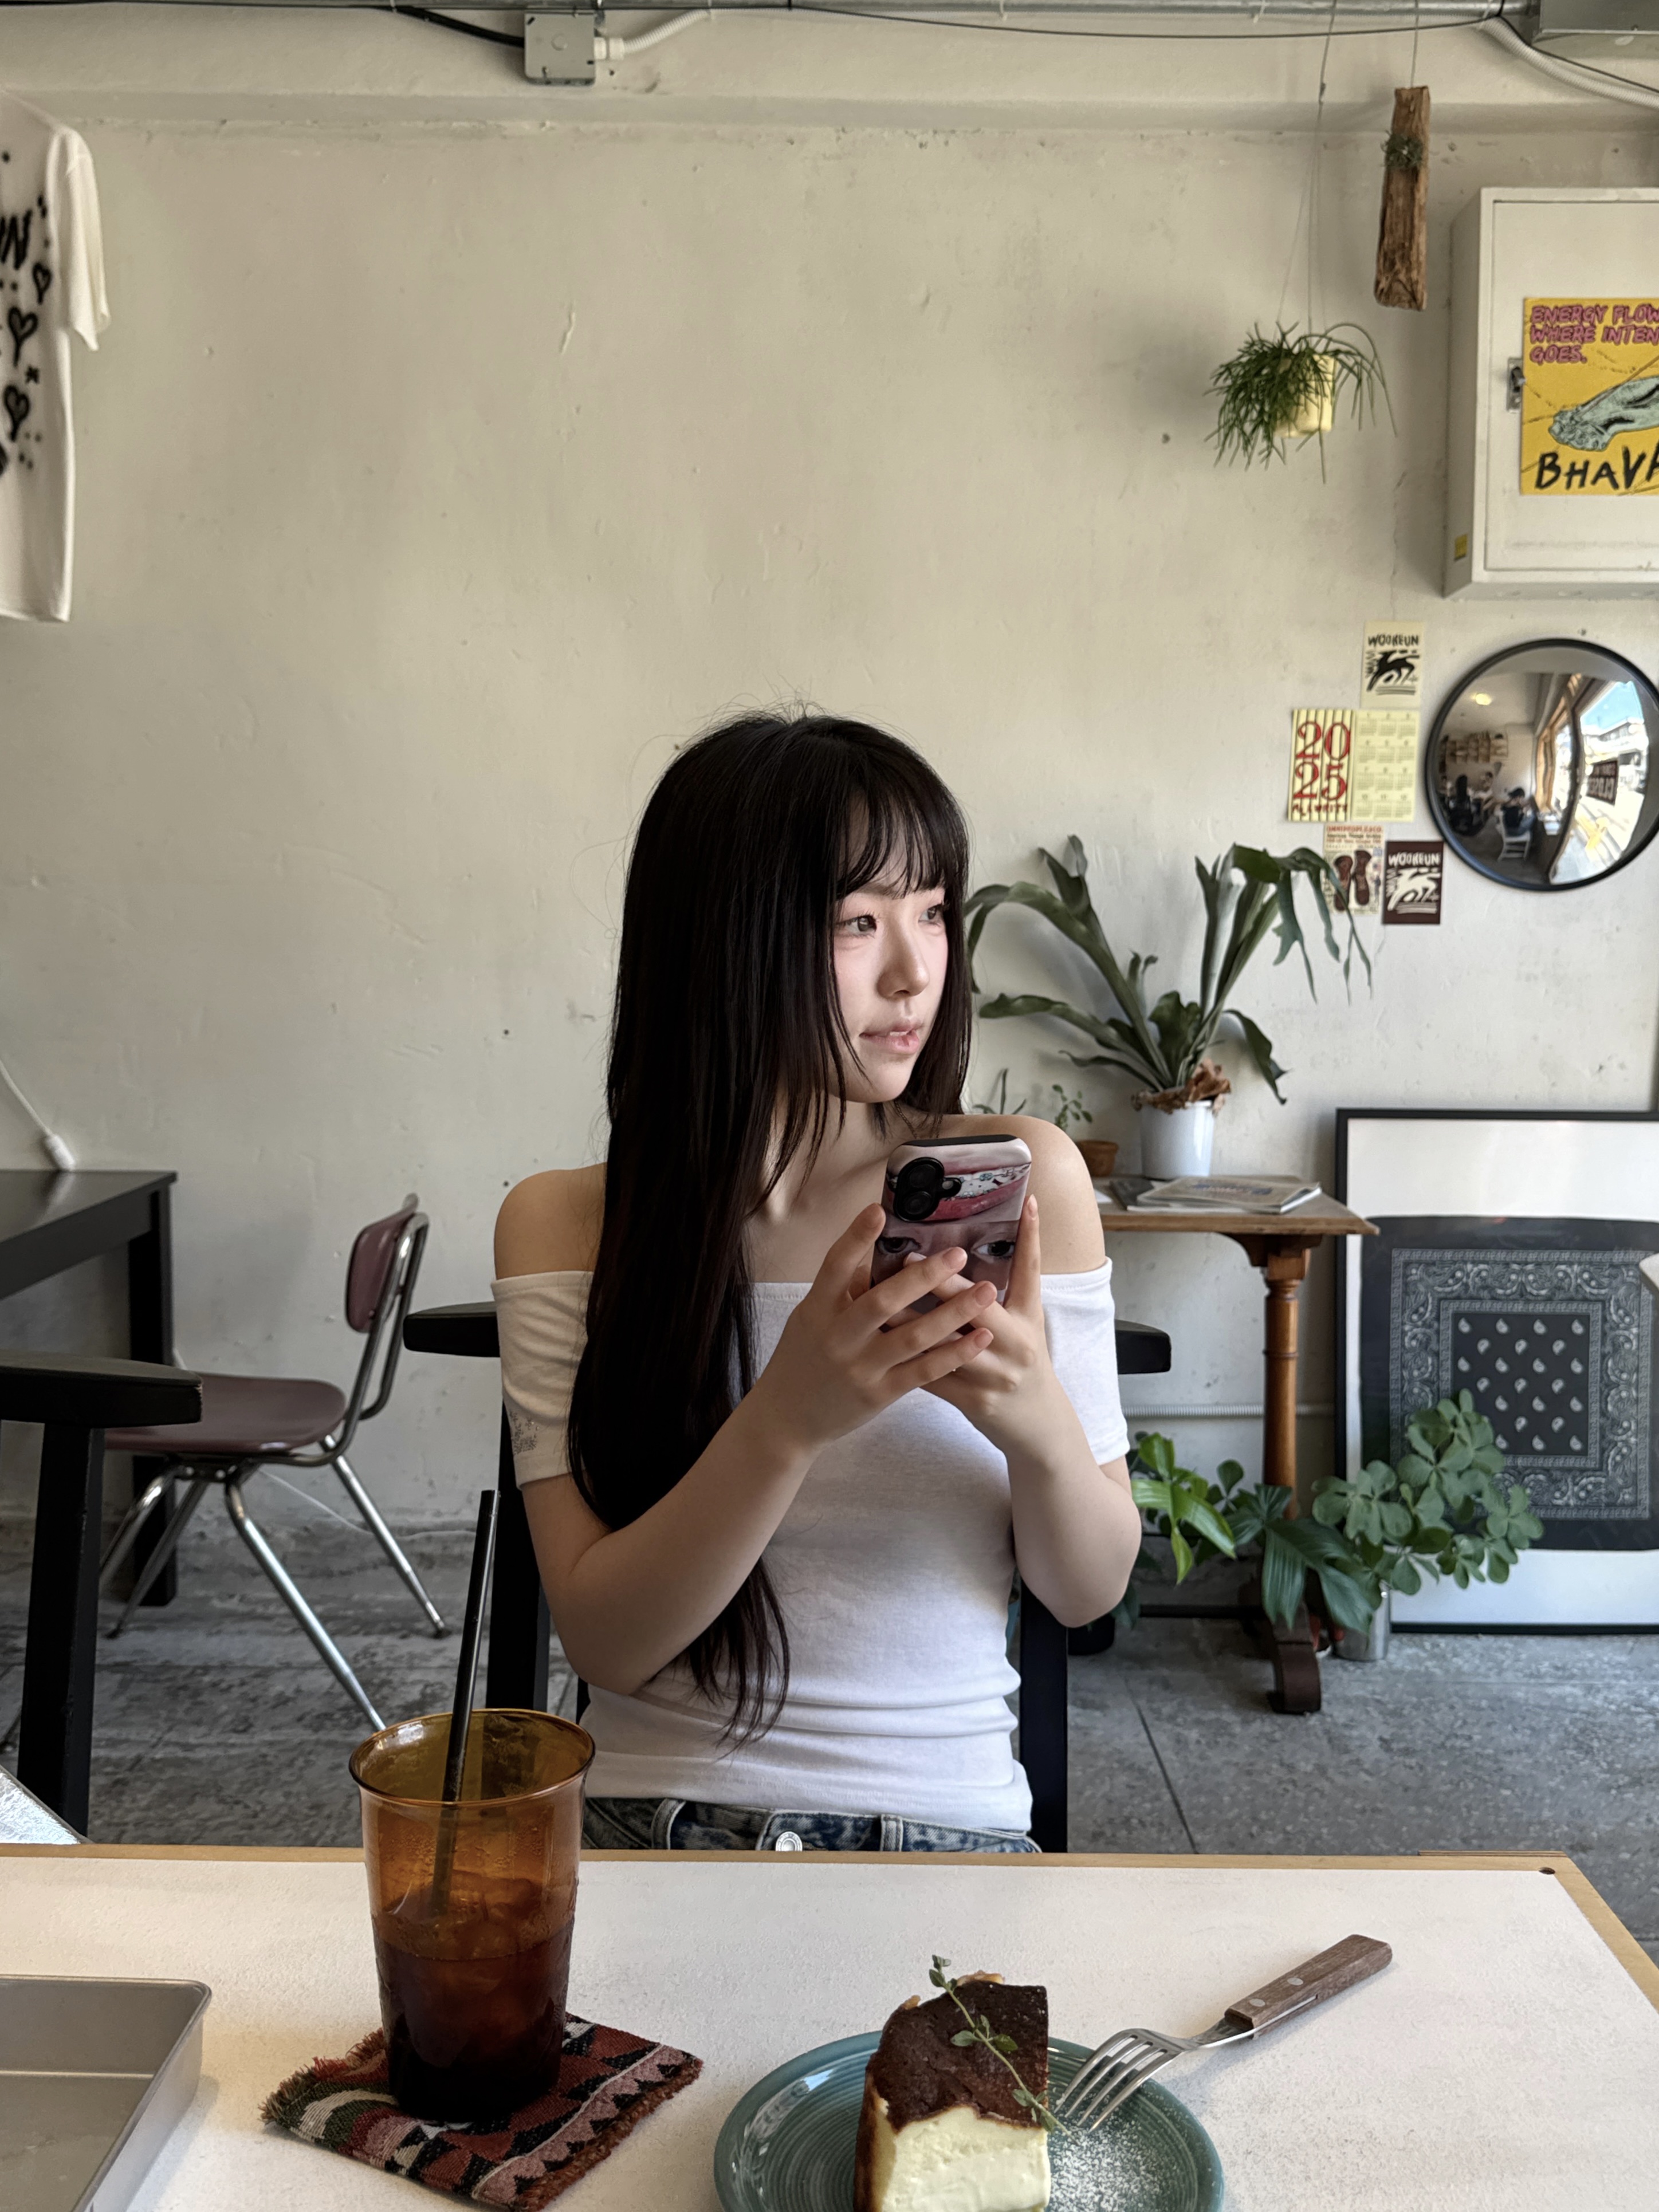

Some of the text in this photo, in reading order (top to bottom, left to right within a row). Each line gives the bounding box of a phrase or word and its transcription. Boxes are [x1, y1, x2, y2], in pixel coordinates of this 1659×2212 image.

[1531, 304, 1607, 325] ENERGY
[1530, 325, 1659, 346] WHERE INTEN
[1530, 344, 1587, 365] GOES.
[1296, 721, 1351, 761] 20
[1293, 761, 1349, 801] 25
